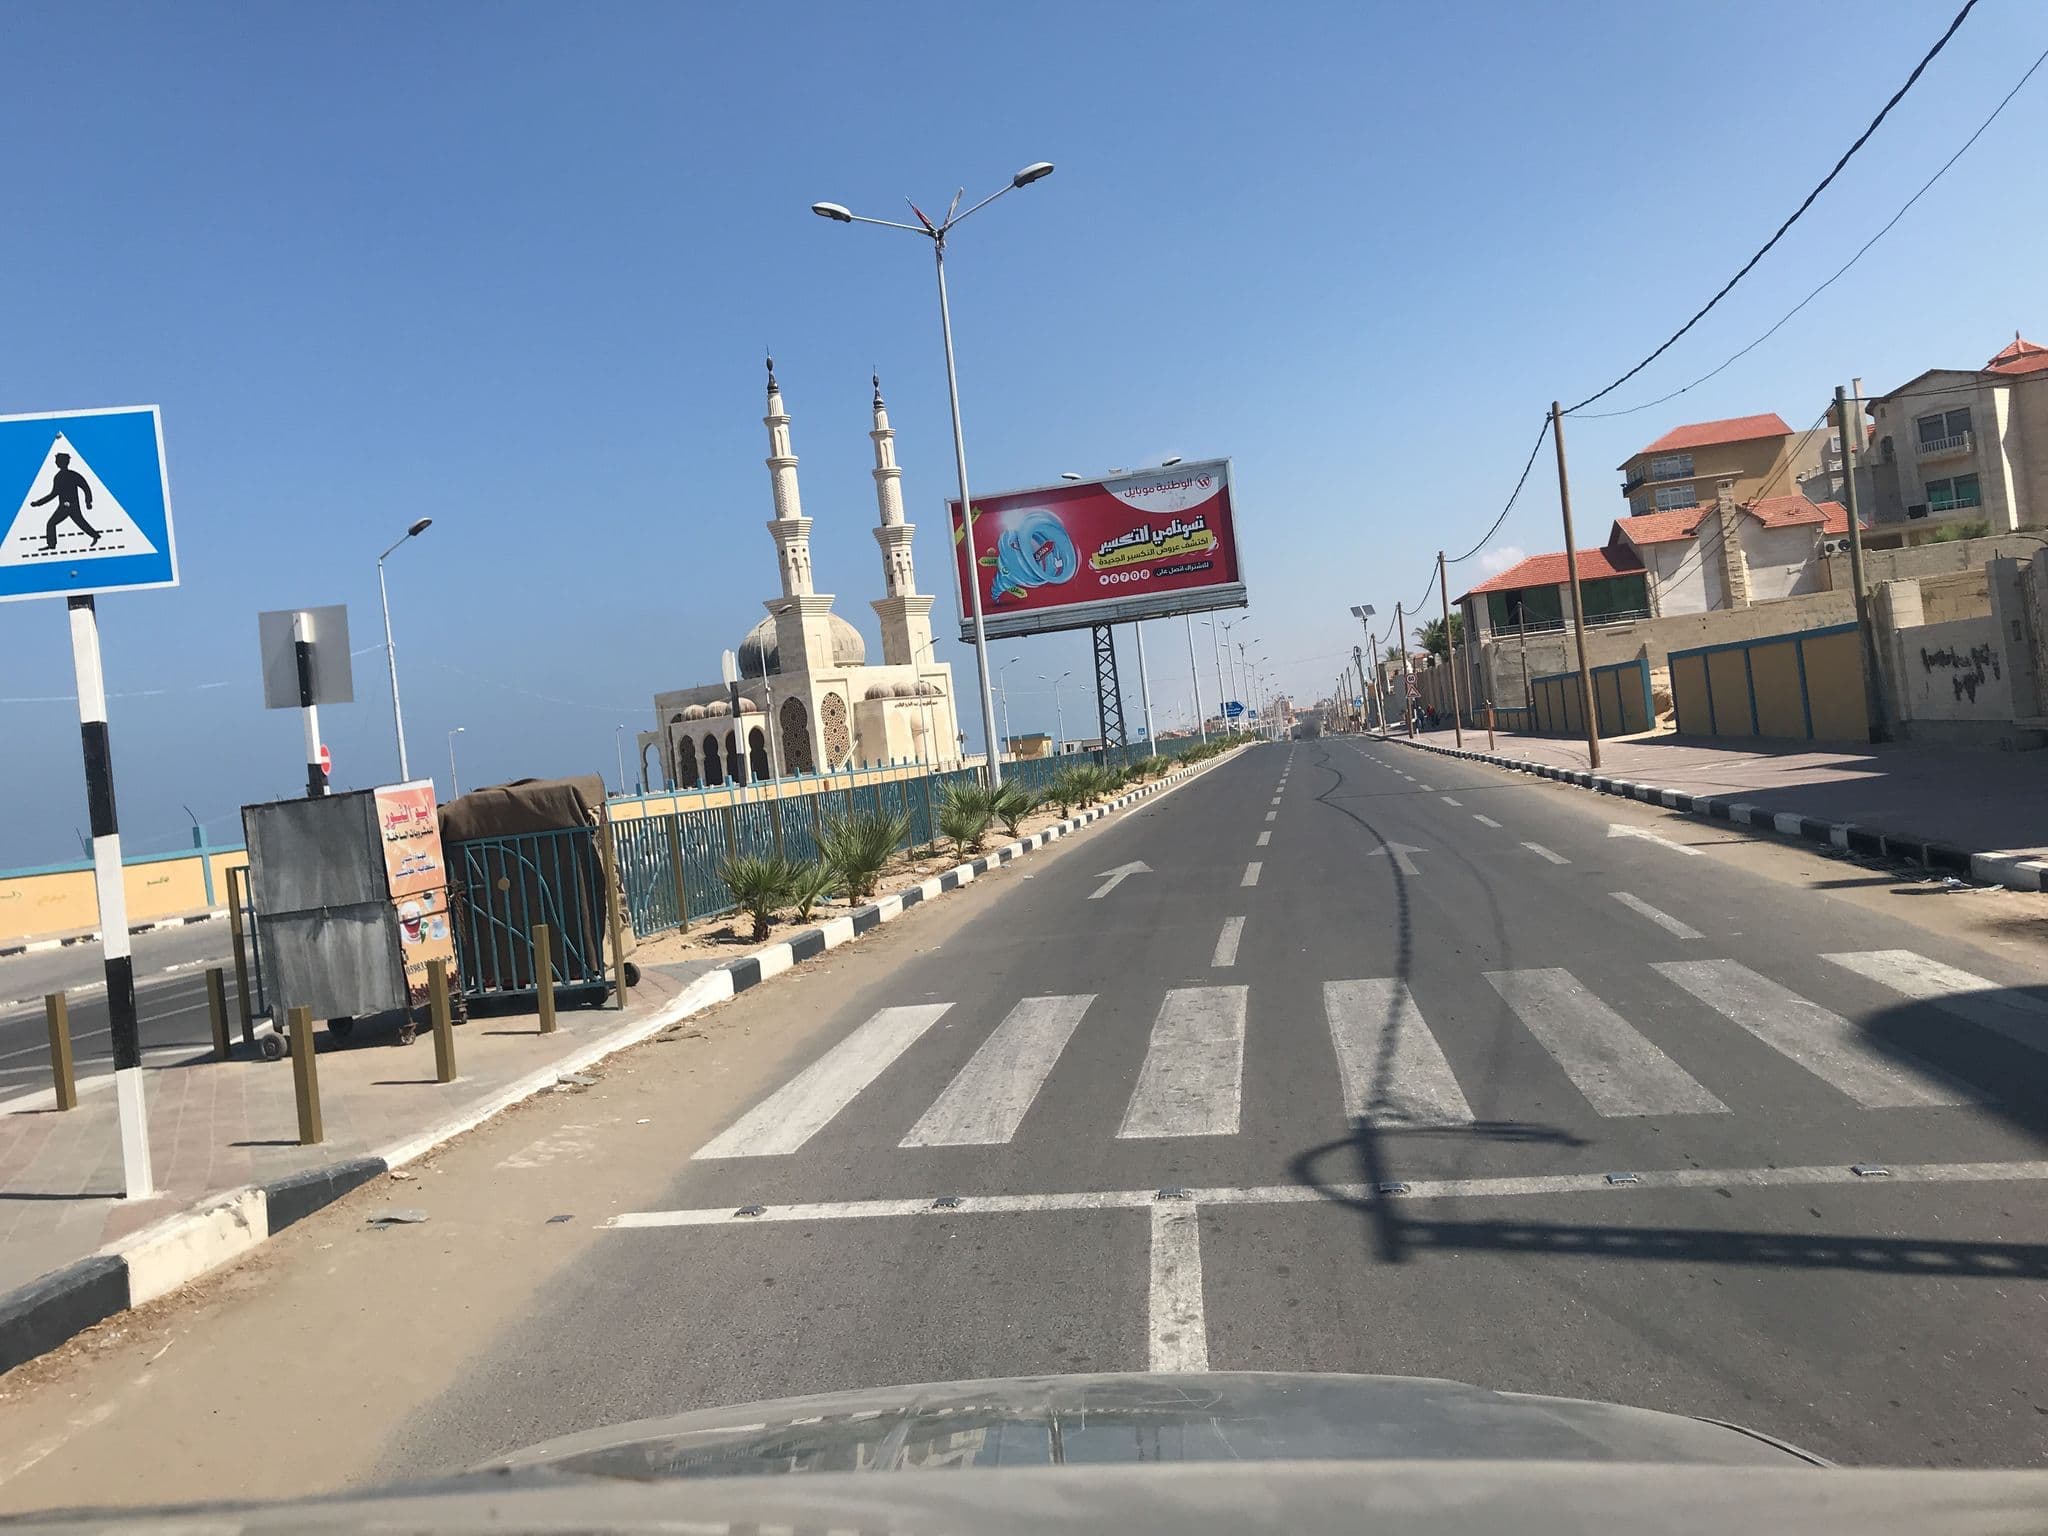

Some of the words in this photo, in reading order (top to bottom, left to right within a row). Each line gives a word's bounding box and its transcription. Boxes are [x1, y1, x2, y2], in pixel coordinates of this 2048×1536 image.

[1157, 478, 1193, 493] الوطنية
[1124, 486, 1155, 499] موبايل
[1152, 515, 1205, 543] تسونامي
[1098, 526, 1149, 555] التكسير
[1181, 537, 1209, 551] اكتشف
[1126, 550, 1155, 562] التكسير
[1156, 546, 1180, 556] عروض
[1098, 557, 1126, 566] الجديدة
